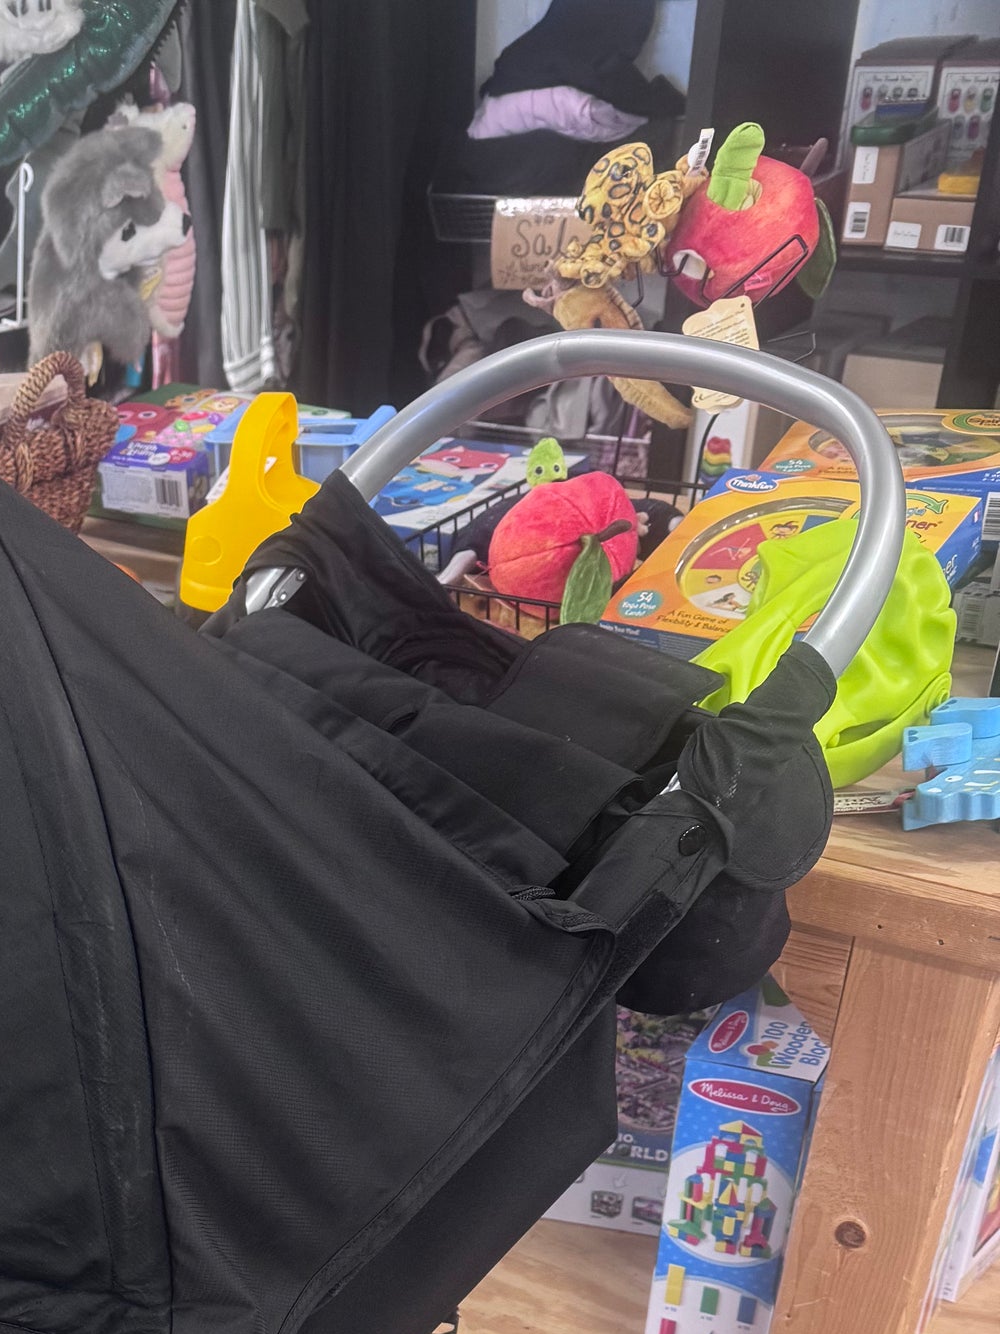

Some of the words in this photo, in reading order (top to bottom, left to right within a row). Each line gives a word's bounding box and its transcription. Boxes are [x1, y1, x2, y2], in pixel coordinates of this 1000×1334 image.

[622, 601, 639, 610] Yoga
[639, 602, 657, 610] Pose
[637, 592, 654, 603] 54
[677, 611, 691, 619] Fun
[693, 614, 717, 623] Game
[761, 1021, 789, 1039] 100
[771, 1021, 811, 1065] Wooden
[799, 1037, 831, 1066] Bloc
[699, 1081, 748, 1101] Melissa
[761, 1095, 791, 1113] Doug
